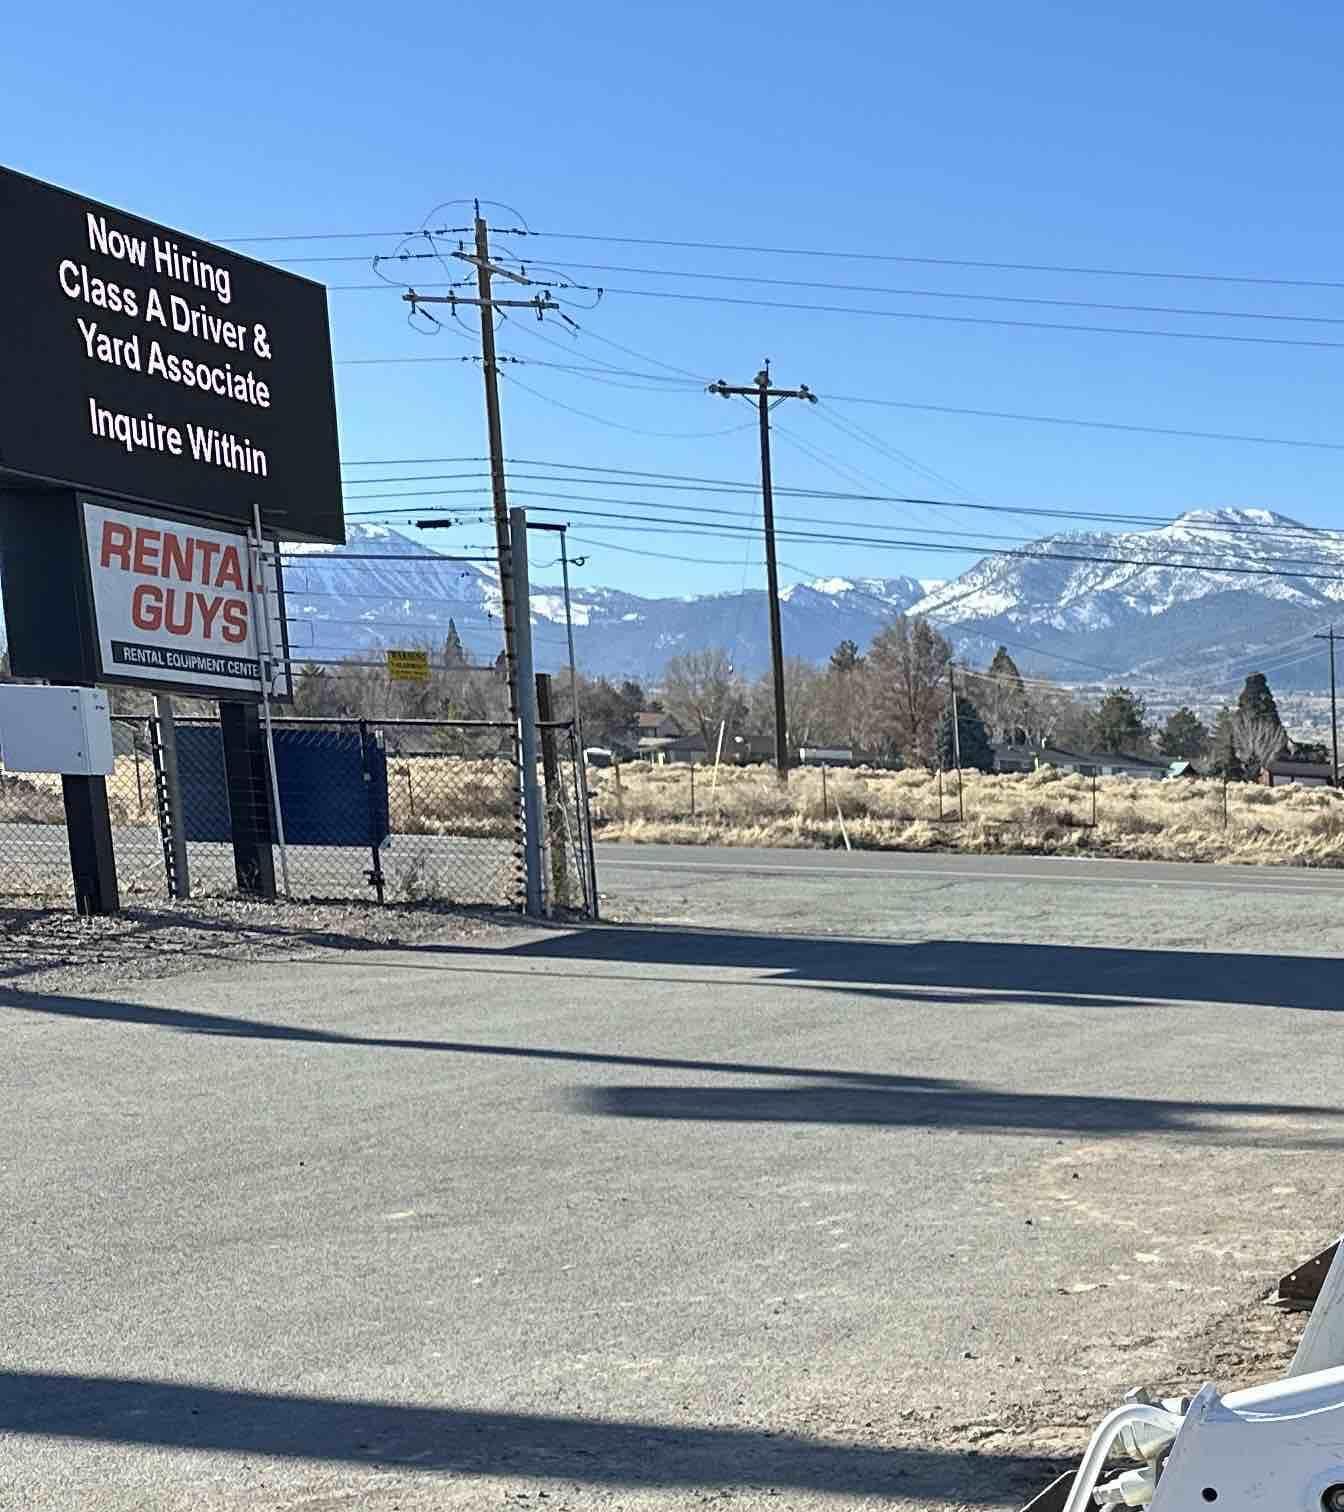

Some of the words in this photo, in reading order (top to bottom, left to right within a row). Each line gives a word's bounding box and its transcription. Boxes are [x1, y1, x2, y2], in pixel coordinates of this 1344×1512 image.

[86, 212, 147, 268] Now
[152, 236, 232, 304] Hiring
[58, 259, 138, 317] Class
[145, 287, 168, 327] A
[170, 294, 246, 352] Driver
[252, 323, 272, 360] &
[76, 317, 142, 372] Yard
[147, 341, 271, 408] Associate
[88, 397, 183, 455] Inquire
[186, 423, 269, 477] Within
[131, 584, 248, 643] GUYS
[123, 646, 165, 667] RENTAL
[165, 653, 226, 674] EQUIPMENT
[226, 661, 259, 677] CENTE
